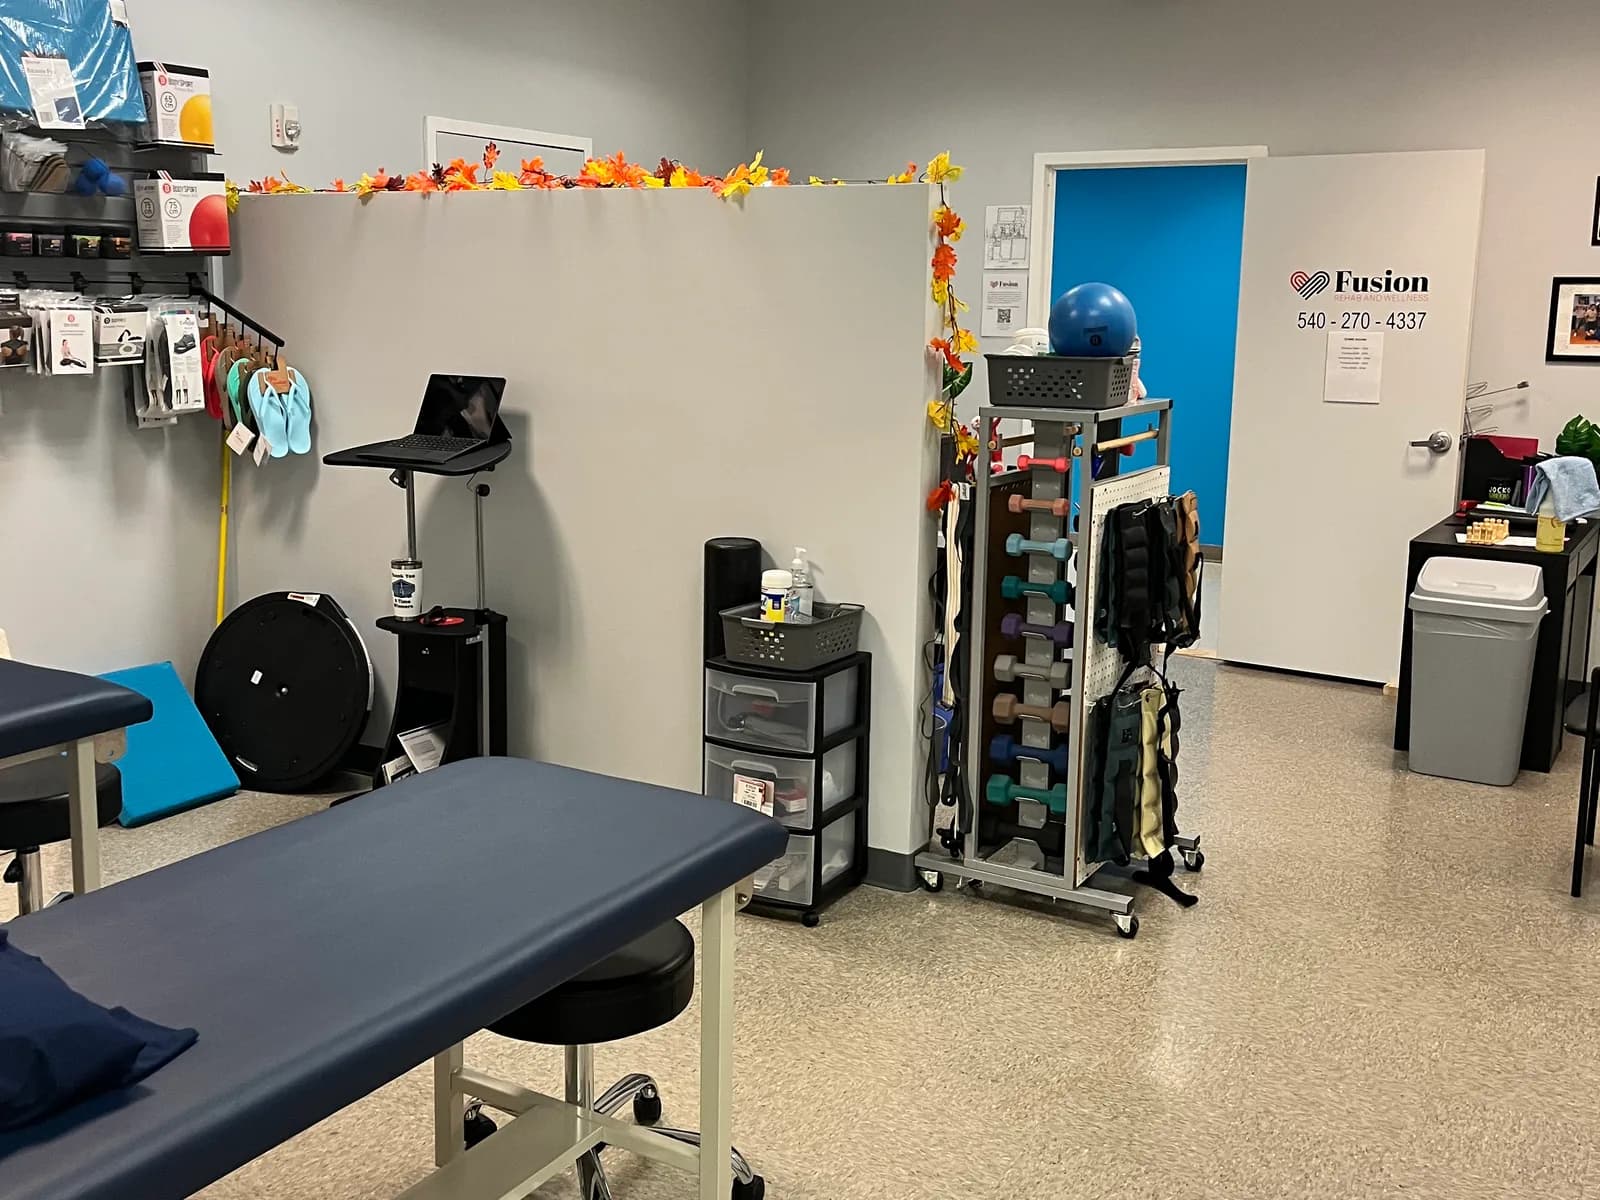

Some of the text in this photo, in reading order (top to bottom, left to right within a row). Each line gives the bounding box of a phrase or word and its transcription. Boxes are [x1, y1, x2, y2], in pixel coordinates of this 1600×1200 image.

[168, 201, 178, 209] 75
[1335, 269, 1429, 293] Fusion
[1335, 294, 1429, 302] REHAB AND WELLNESS
[1297, 312, 1326, 329] 540
[1341, 312, 1370, 329] 270
[1386, 312, 1427, 329] 4337
[1489, 486, 1511, 494] JOCKO
